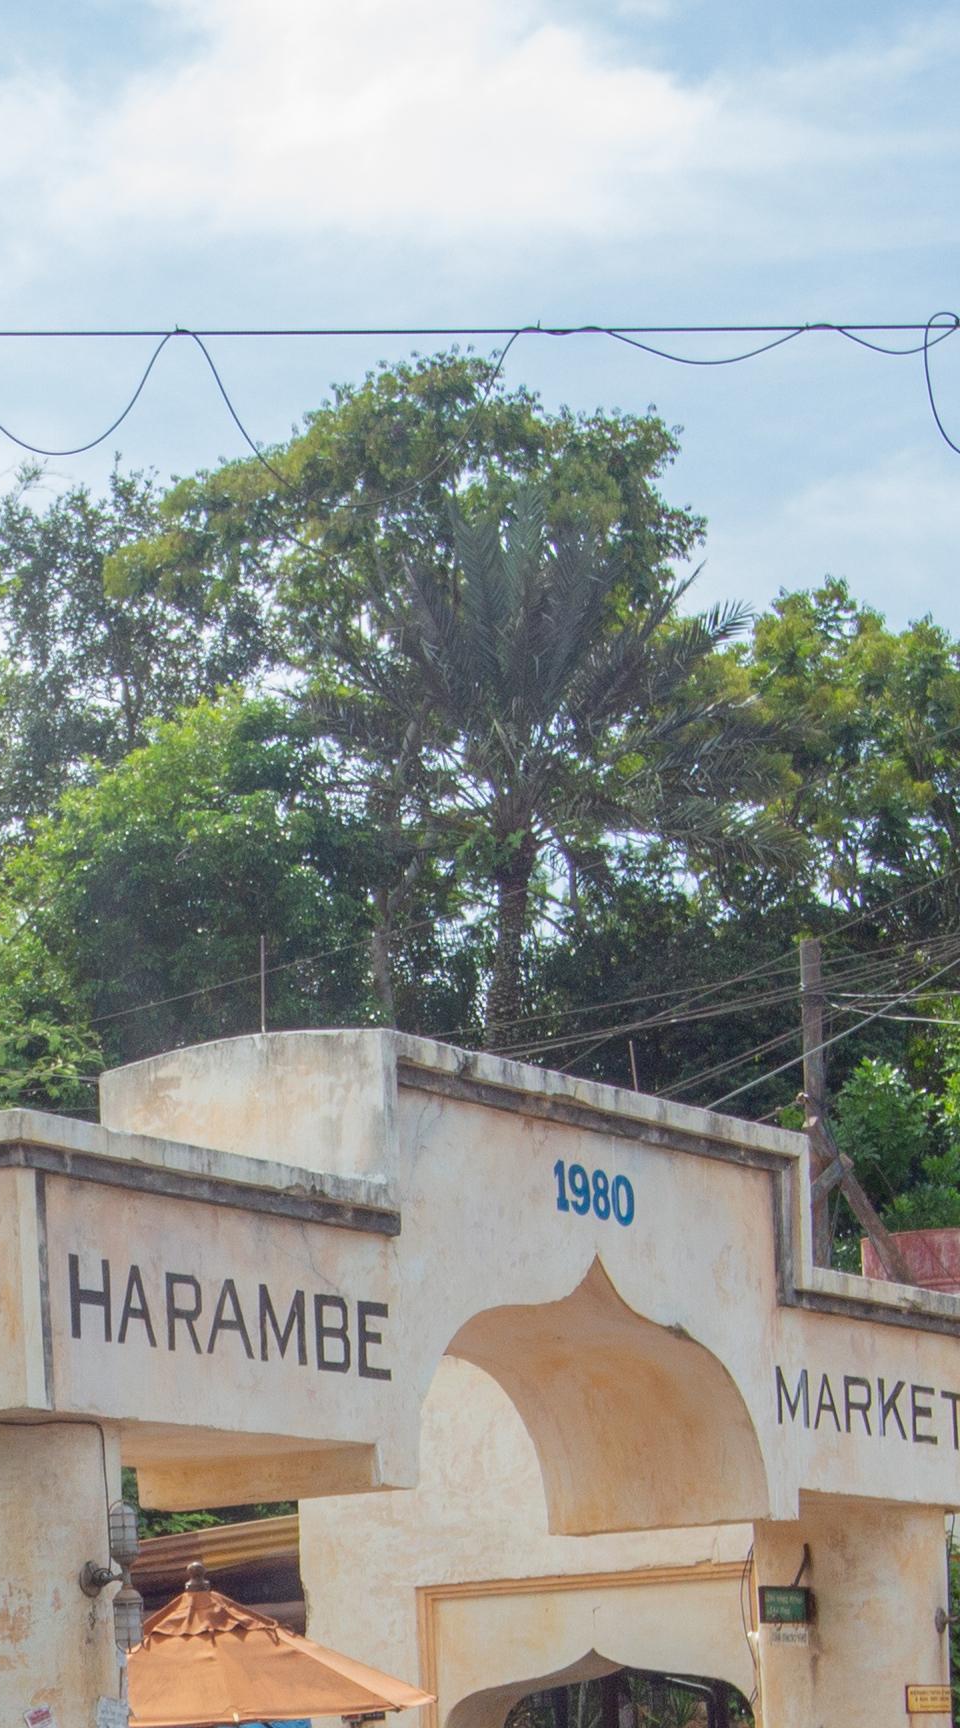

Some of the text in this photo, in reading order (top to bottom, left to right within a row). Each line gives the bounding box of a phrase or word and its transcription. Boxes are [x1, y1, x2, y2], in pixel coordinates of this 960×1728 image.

[553, 1159, 635, 1227] 1980
[68, 1253, 392, 1382] HARAMBE
[775, 1366, 960, 1451] MARKET
